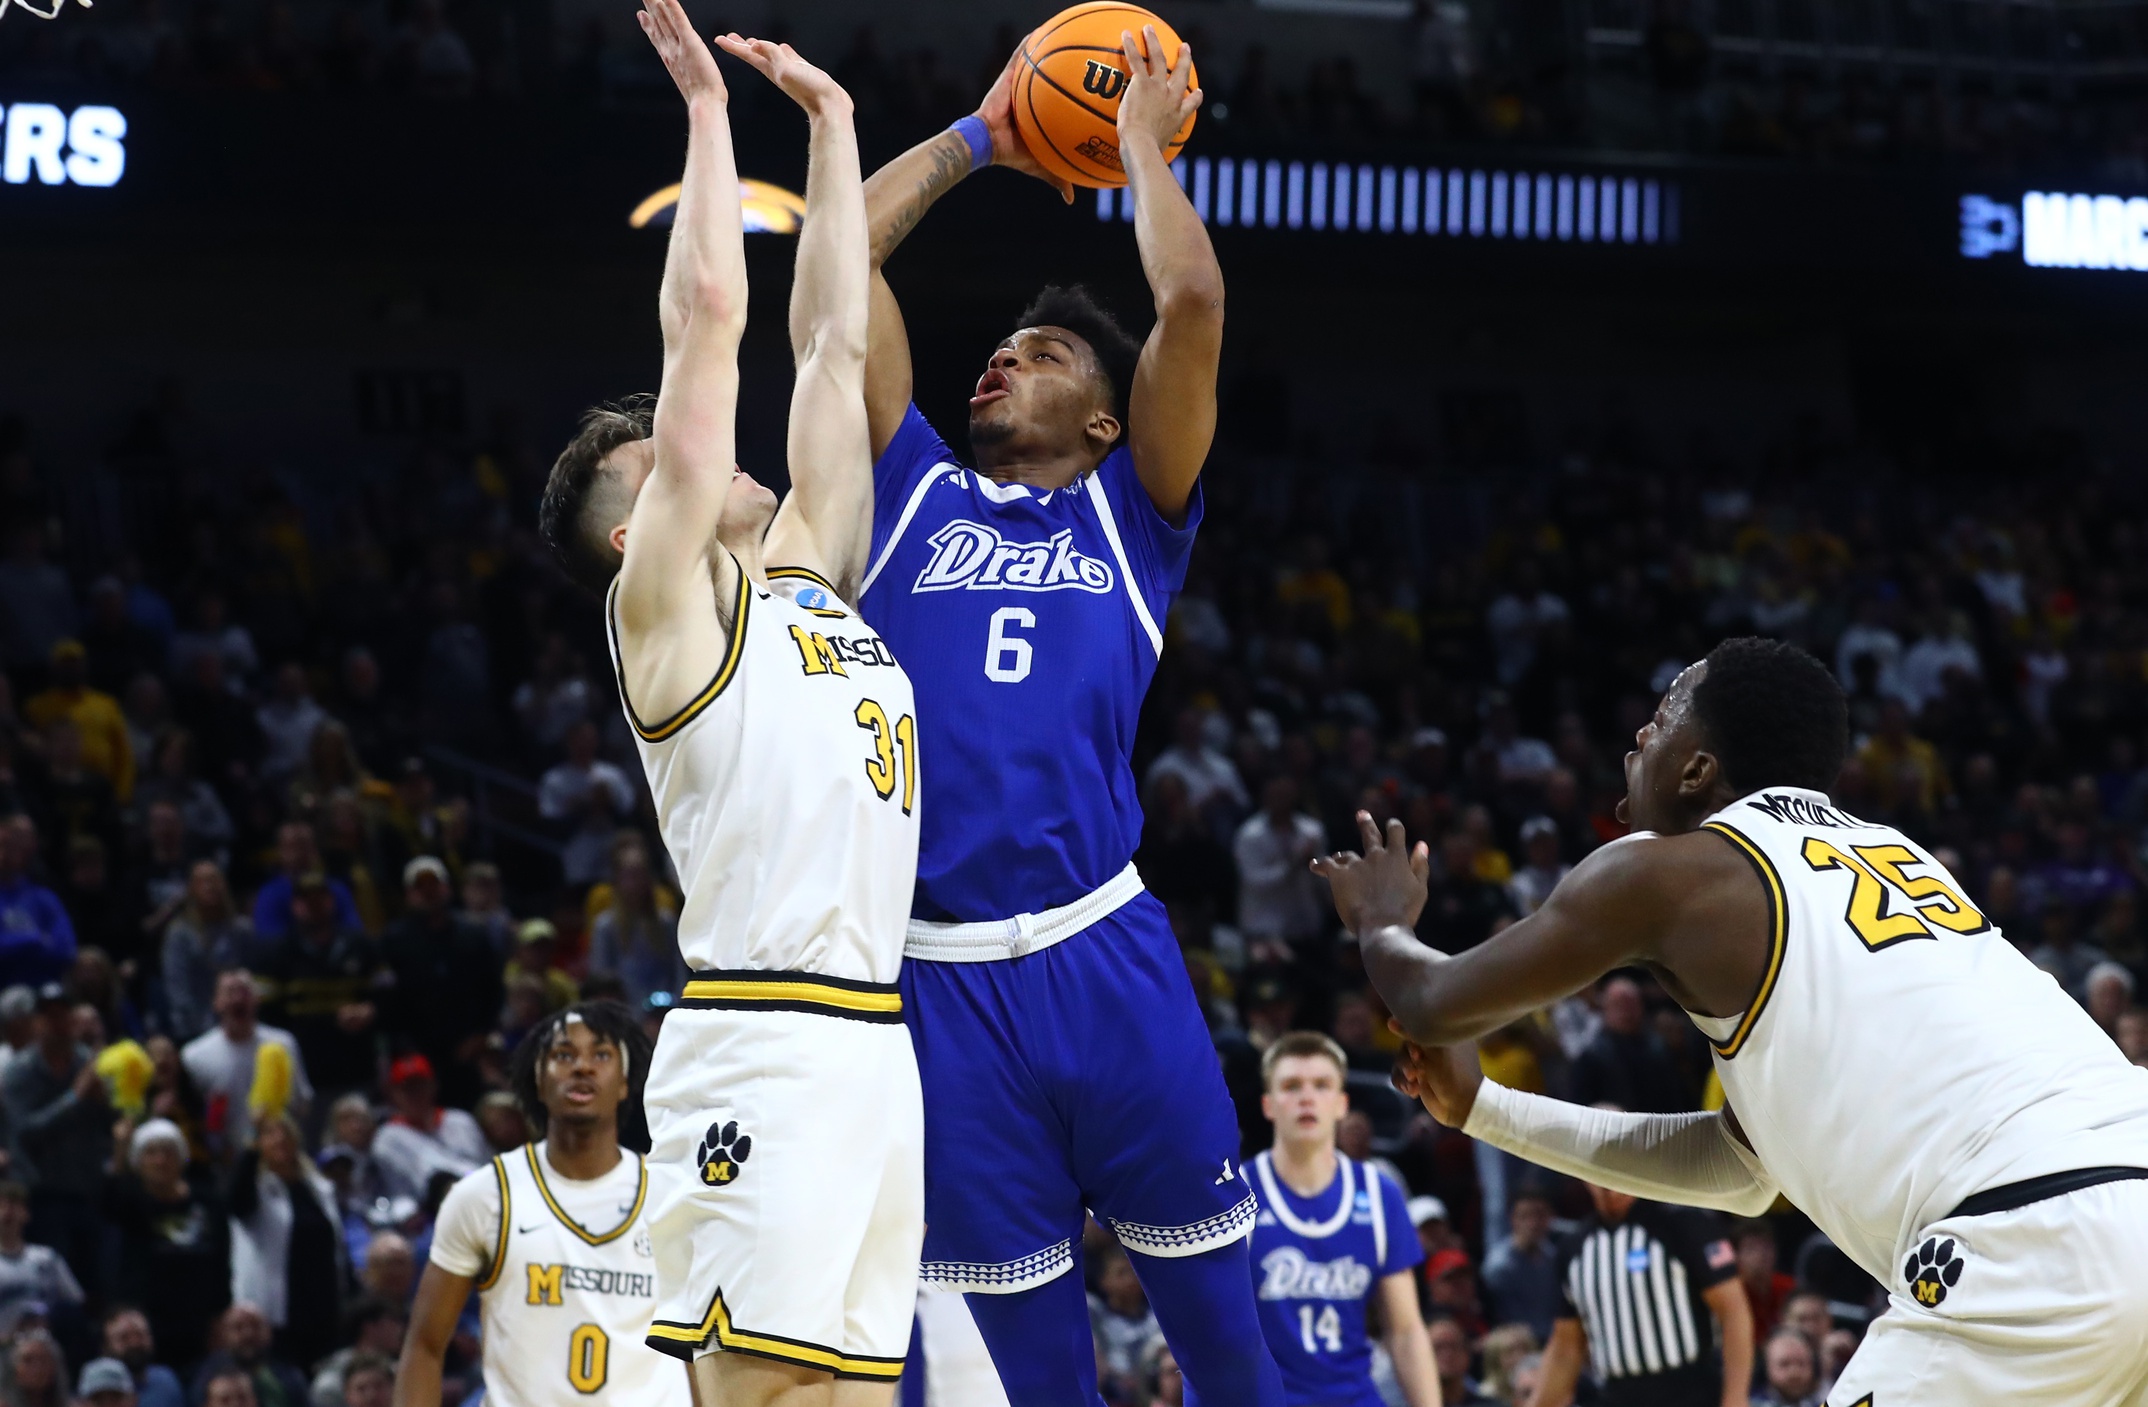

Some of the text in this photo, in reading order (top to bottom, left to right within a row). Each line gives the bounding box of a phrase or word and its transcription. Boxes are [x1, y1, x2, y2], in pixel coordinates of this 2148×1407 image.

[0, 101, 127, 188] RS
[911, 519, 1114, 594] Drake
[984, 607, 1036, 683] 6
[854, 698, 915, 817] 31
[1800, 836, 1991, 953] 25
[706, 1161, 731, 1182] M
[526, 1262, 653, 1306] MISSOURI
[1258, 1245, 1372, 1300] Drake
[1917, 1279, 1940, 1304] M
[568, 1322, 610, 1395] 0
[1299, 1304, 1342, 1353] 14
